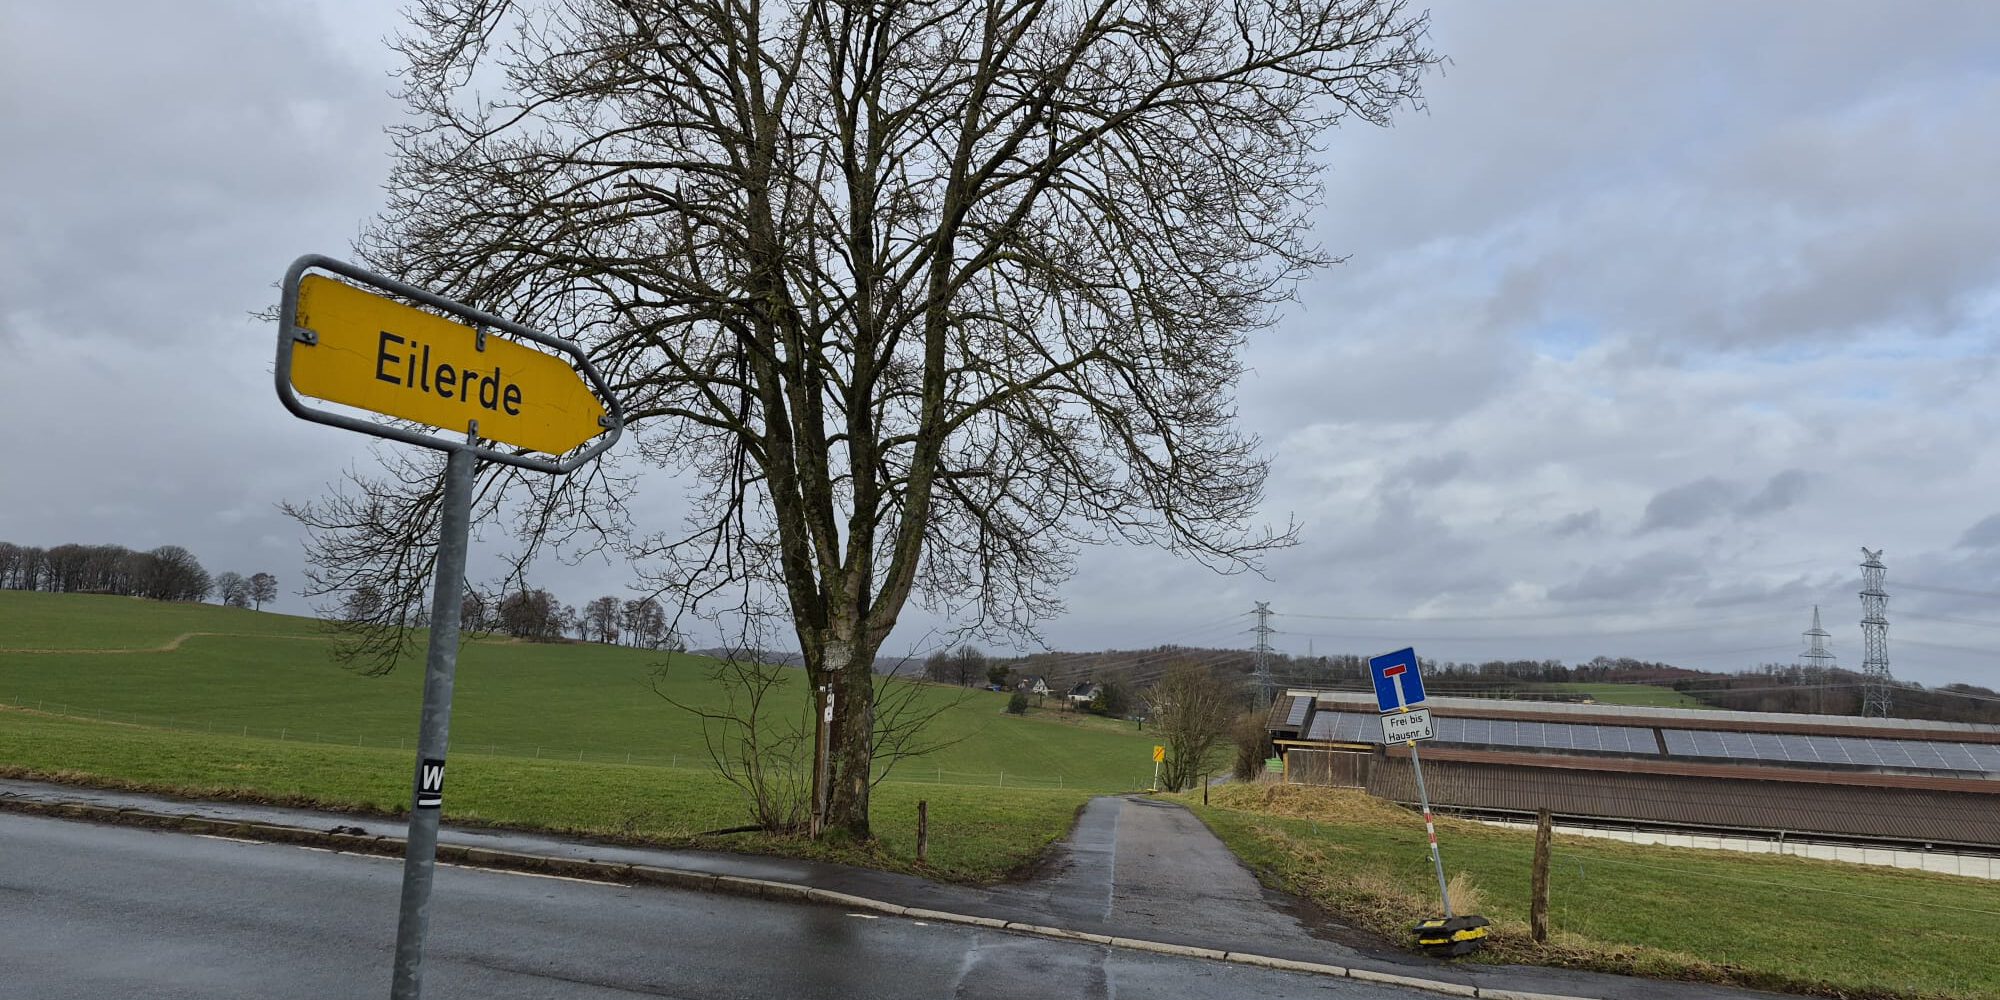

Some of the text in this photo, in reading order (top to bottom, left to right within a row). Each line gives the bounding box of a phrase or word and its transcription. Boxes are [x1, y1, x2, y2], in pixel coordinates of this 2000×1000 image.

[376, 331, 522, 416] Eilerde
[1390, 714, 1424, 728] Frei bis
[1388, 726, 1430, 742] Hausnr. 6
[423, 765, 445, 790] W
